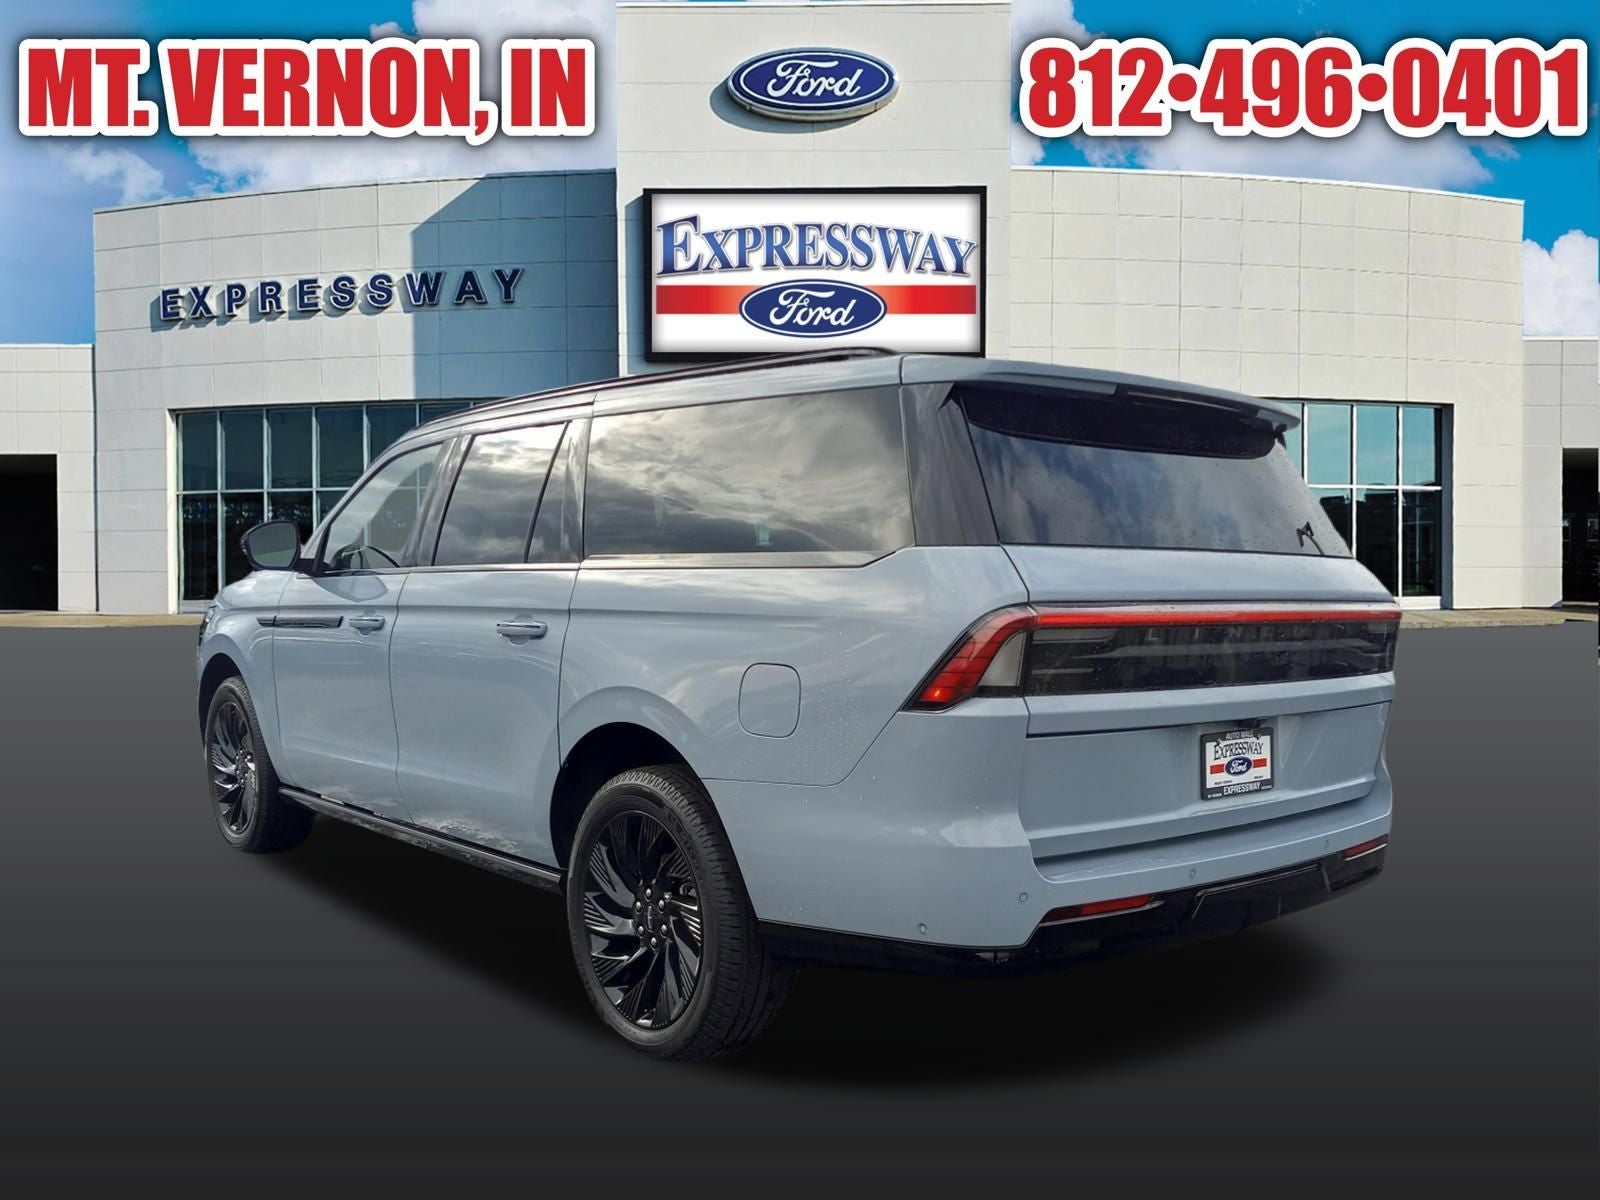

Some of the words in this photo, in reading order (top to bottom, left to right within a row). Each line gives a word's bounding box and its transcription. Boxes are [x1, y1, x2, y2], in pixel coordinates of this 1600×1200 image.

[767, 59, 863, 97] Ford
[656, 214, 977, 277] EXPRESSWAY
[160, 267, 525, 321] EXPRESSWAY
[769, 288, 857, 326] Ford
[1226, 732, 1240, 740] AUTO
[1214, 741, 1264, 761] EXPRESSWAY
[1229, 759, 1248, 774] Ford
[1224, 781, 1261, 796] EXPRESSWAY
